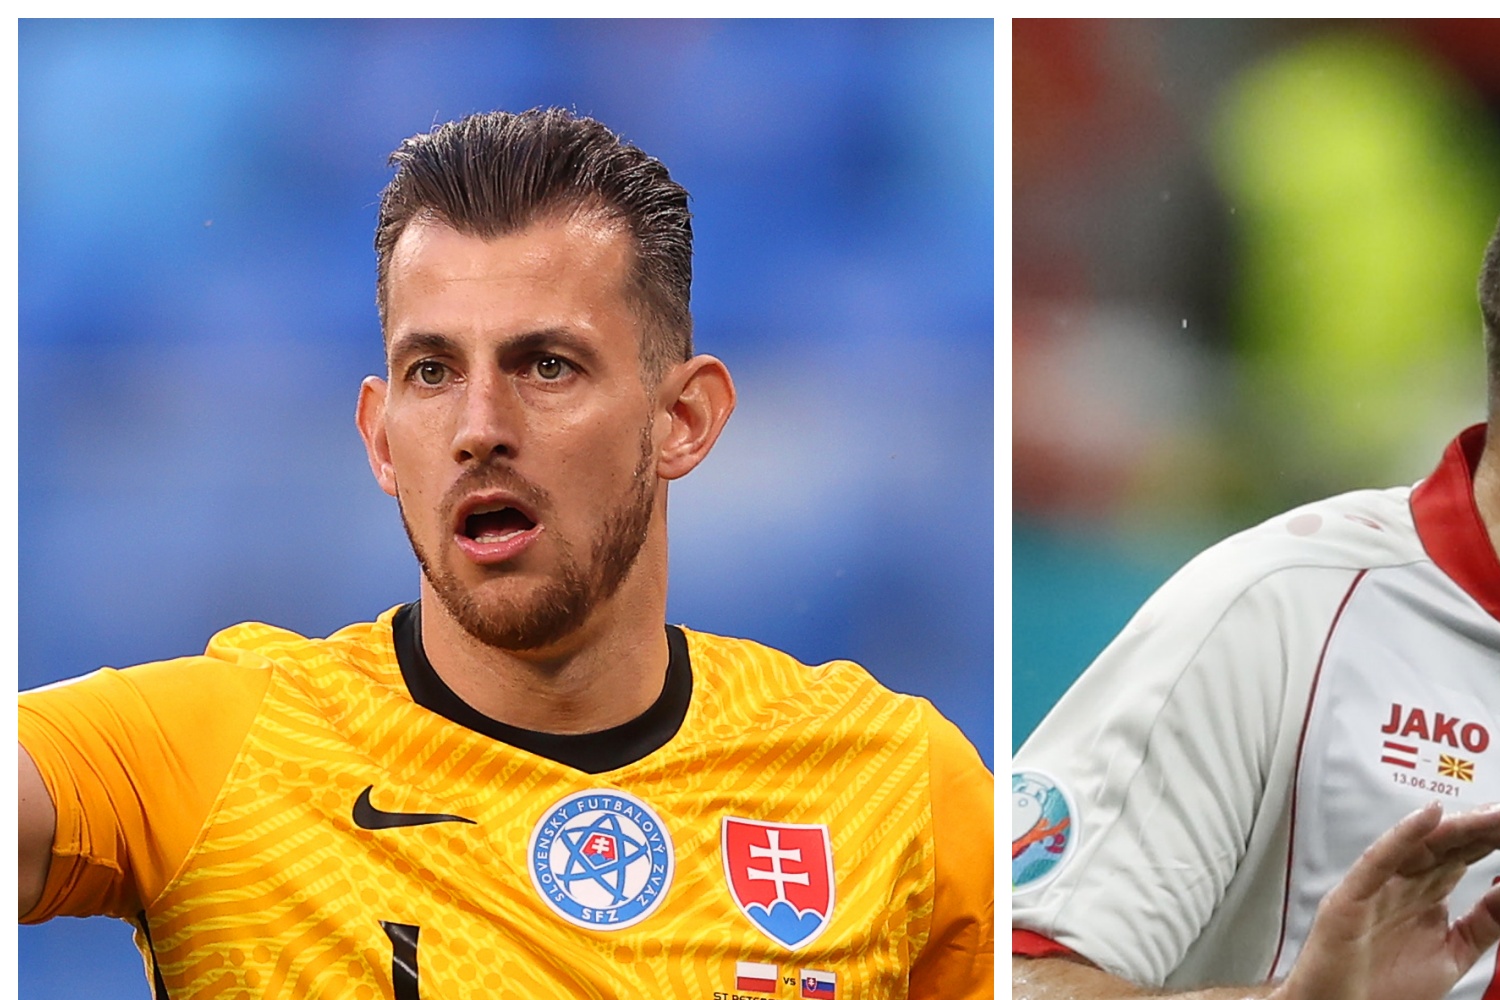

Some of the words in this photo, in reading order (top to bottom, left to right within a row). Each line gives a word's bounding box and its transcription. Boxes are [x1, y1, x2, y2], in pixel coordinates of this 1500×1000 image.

[1381, 703, 1490, 754] JAKO
[1392, 772, 1460, 797] 13.06.2021
[537, 808, 568, 903] SLOVENSKÝ
[577, 798, 666, 854] FUTBALOVÝ
[581, 908, 619, 923] SFZ
